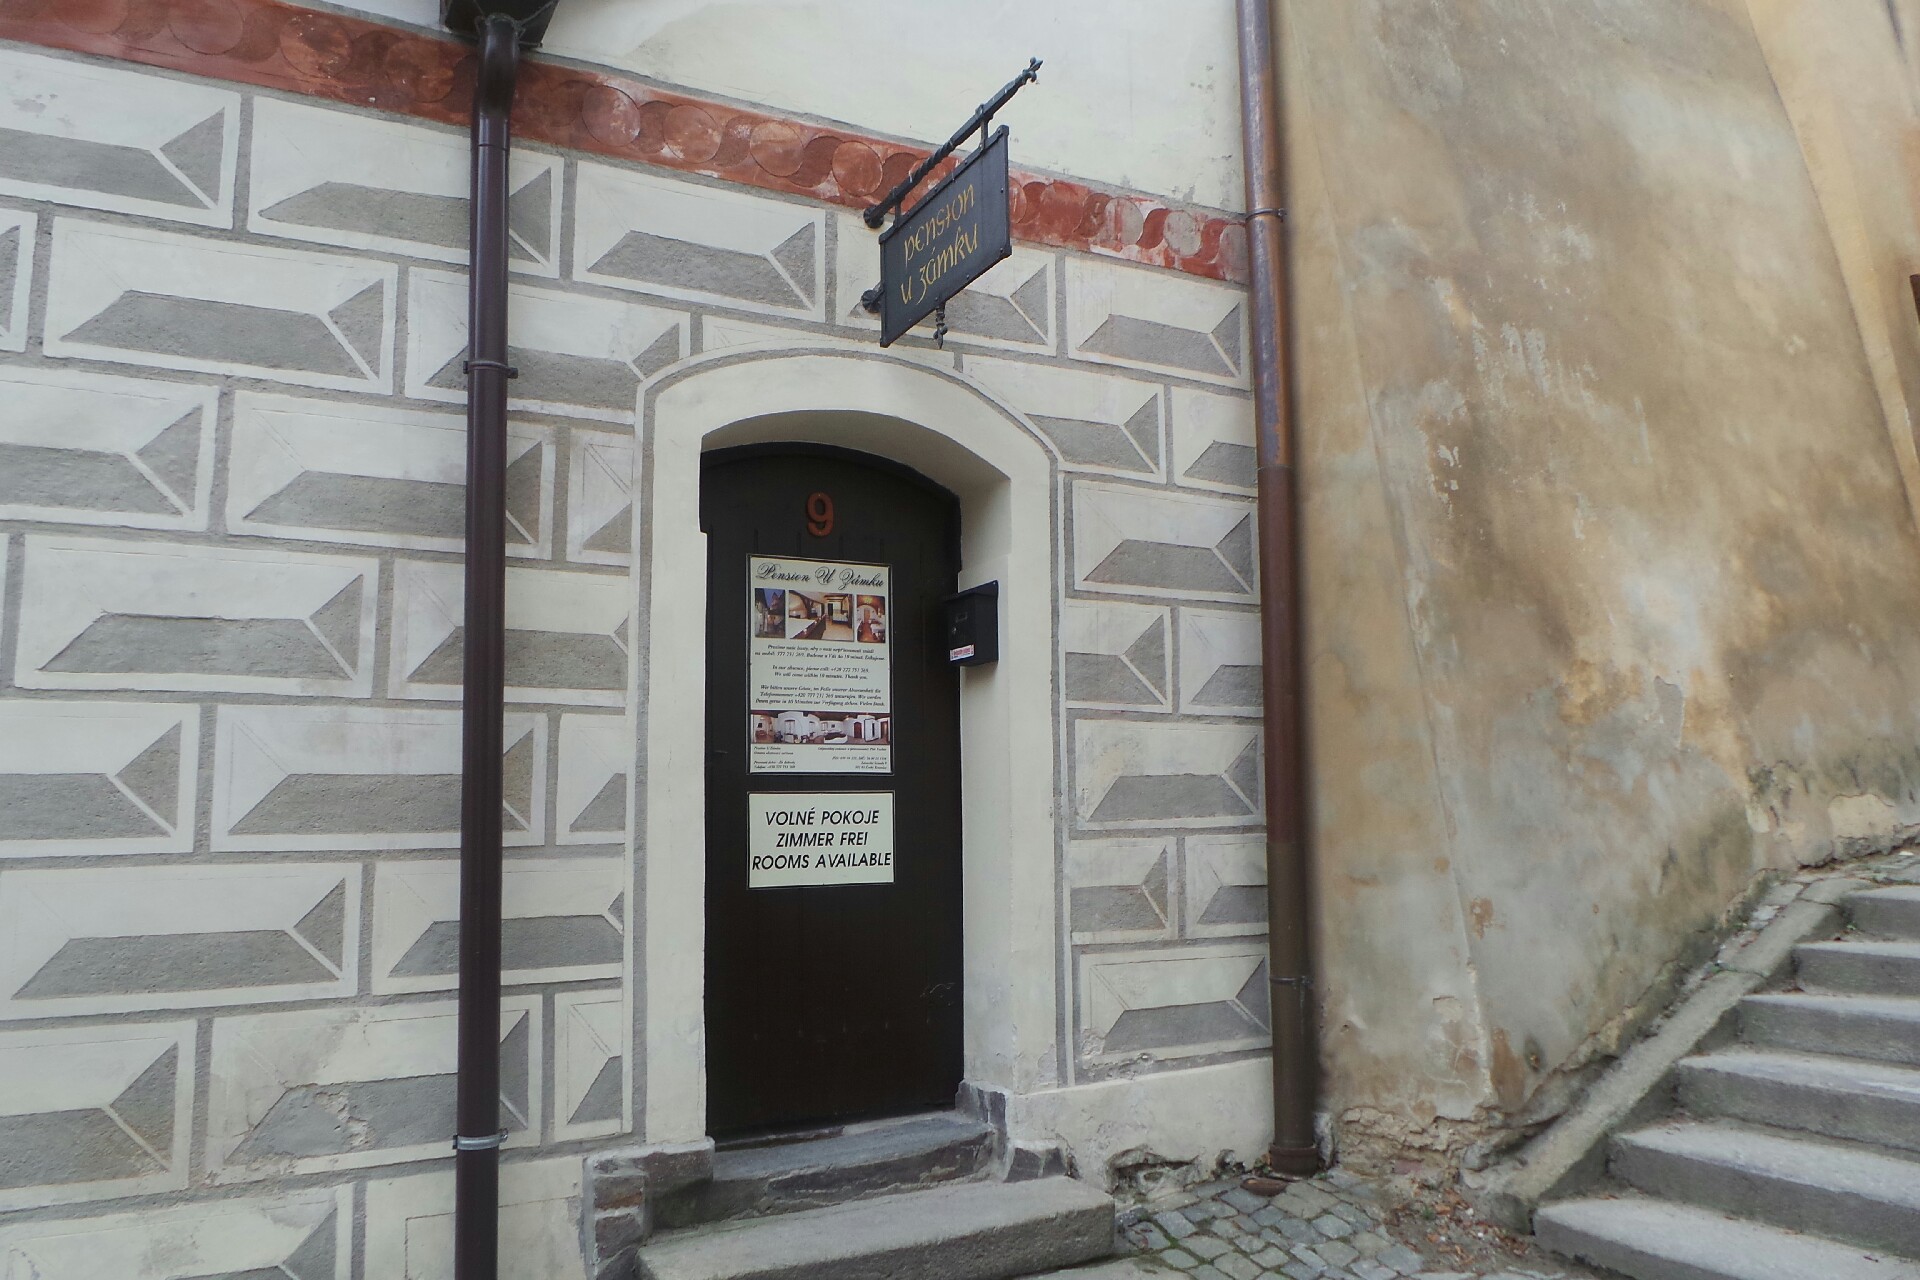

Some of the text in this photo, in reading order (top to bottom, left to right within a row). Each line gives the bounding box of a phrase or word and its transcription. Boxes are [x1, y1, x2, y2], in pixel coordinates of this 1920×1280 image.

[806, 491, 834, 537] 9
[755, 562, 884, 591] Pension U Zámku
[765, 807, 880, 826] VOLNÉ POKOJE
[776, 831, 869, 848] ZIMMER FREI
[752, 852, 892, 870] ROOMS AVAILABLE
